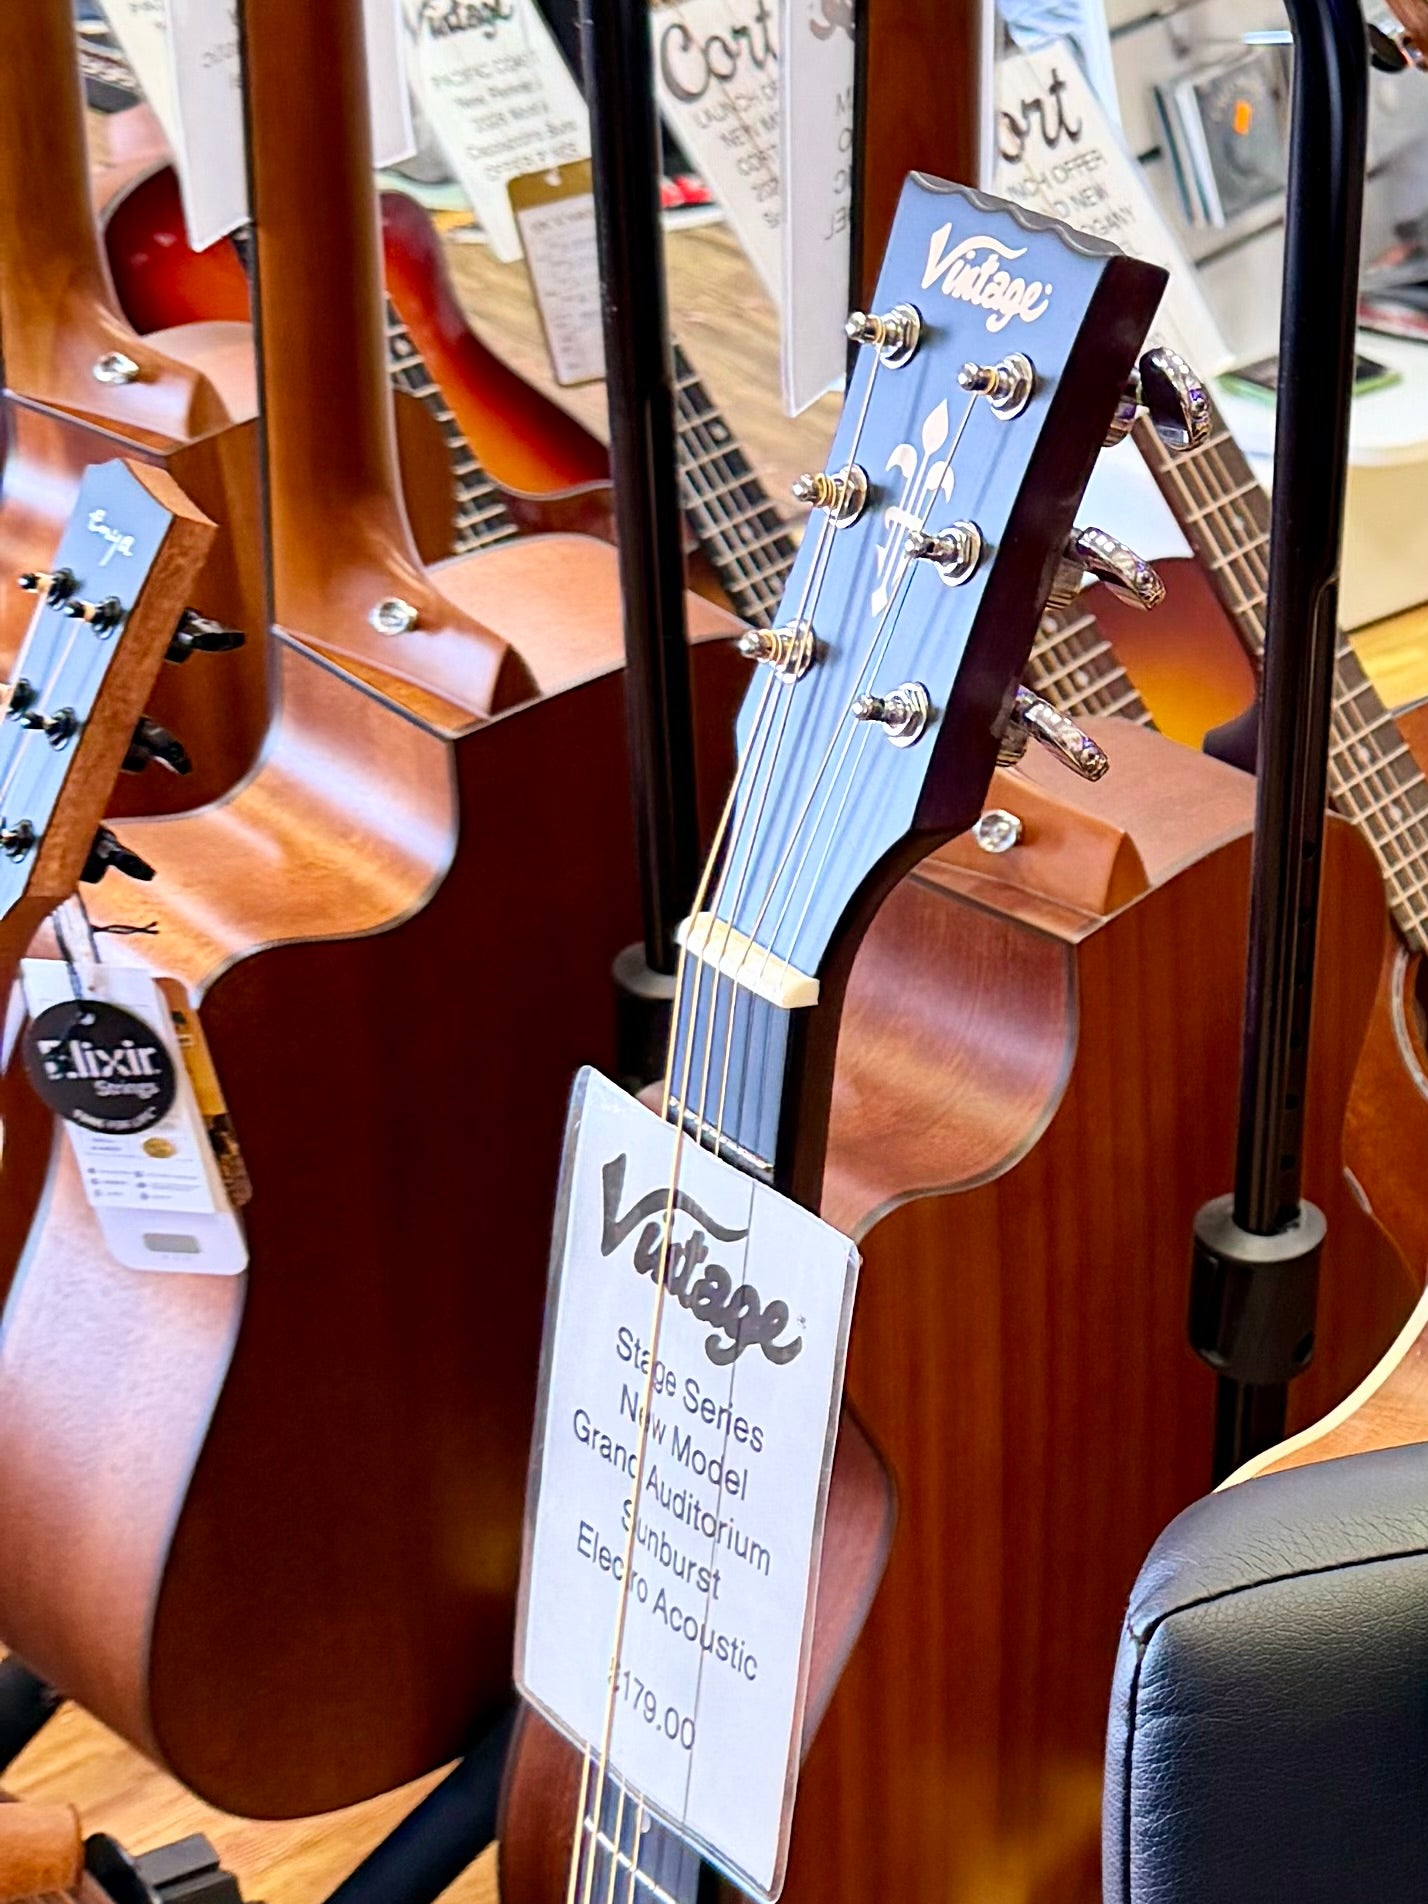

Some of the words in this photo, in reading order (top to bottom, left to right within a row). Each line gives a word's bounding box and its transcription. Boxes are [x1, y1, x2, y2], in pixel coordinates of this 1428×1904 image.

[1000, 68, 1083, 164] ort
[921, 222, 1053, 334] Vintage
[37, 1039, 163, 1080] Elixir
[601, 1152, 804, 1367] Vintage
[615, 1326, 677, 1398] Stage
[684, 1376, 766, 1454] Series
[619, 1383, 669, 1447] New
[671, 1426, 750, 1501] Model
[620, 1498, 723, 1604] Sunburst
[645, 1462, 773, 1577] Auditorium
[576, 1520, 650, 1604] Elecro
[651, 1589, 760, 1684] Acoustic
